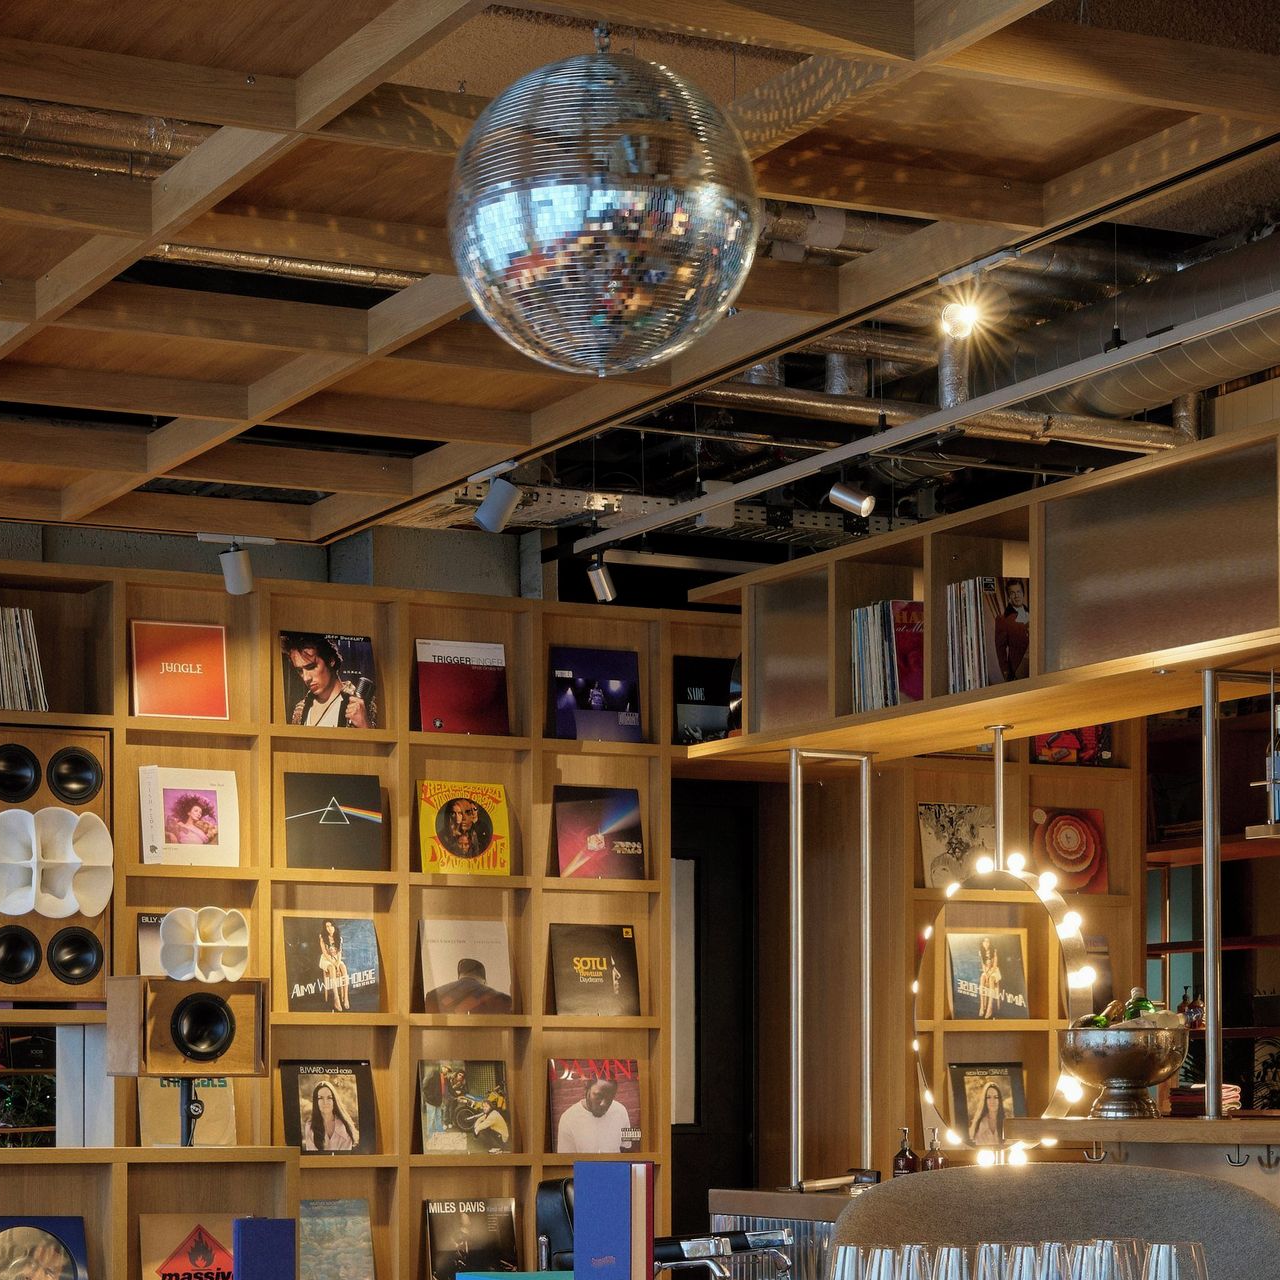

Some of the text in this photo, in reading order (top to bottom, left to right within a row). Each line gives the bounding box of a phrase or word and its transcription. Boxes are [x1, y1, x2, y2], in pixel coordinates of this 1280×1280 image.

[431, 654, 504, 667] TRIGGERFINGER
[687, 687, 705, 701] SADE
[573, 957, 607, 971] SOTU
[292, 979, 317, 999] AMY
[428, 1202, 457, 1214] MILES
[459, 1201, 486, 1213] DAVIS
